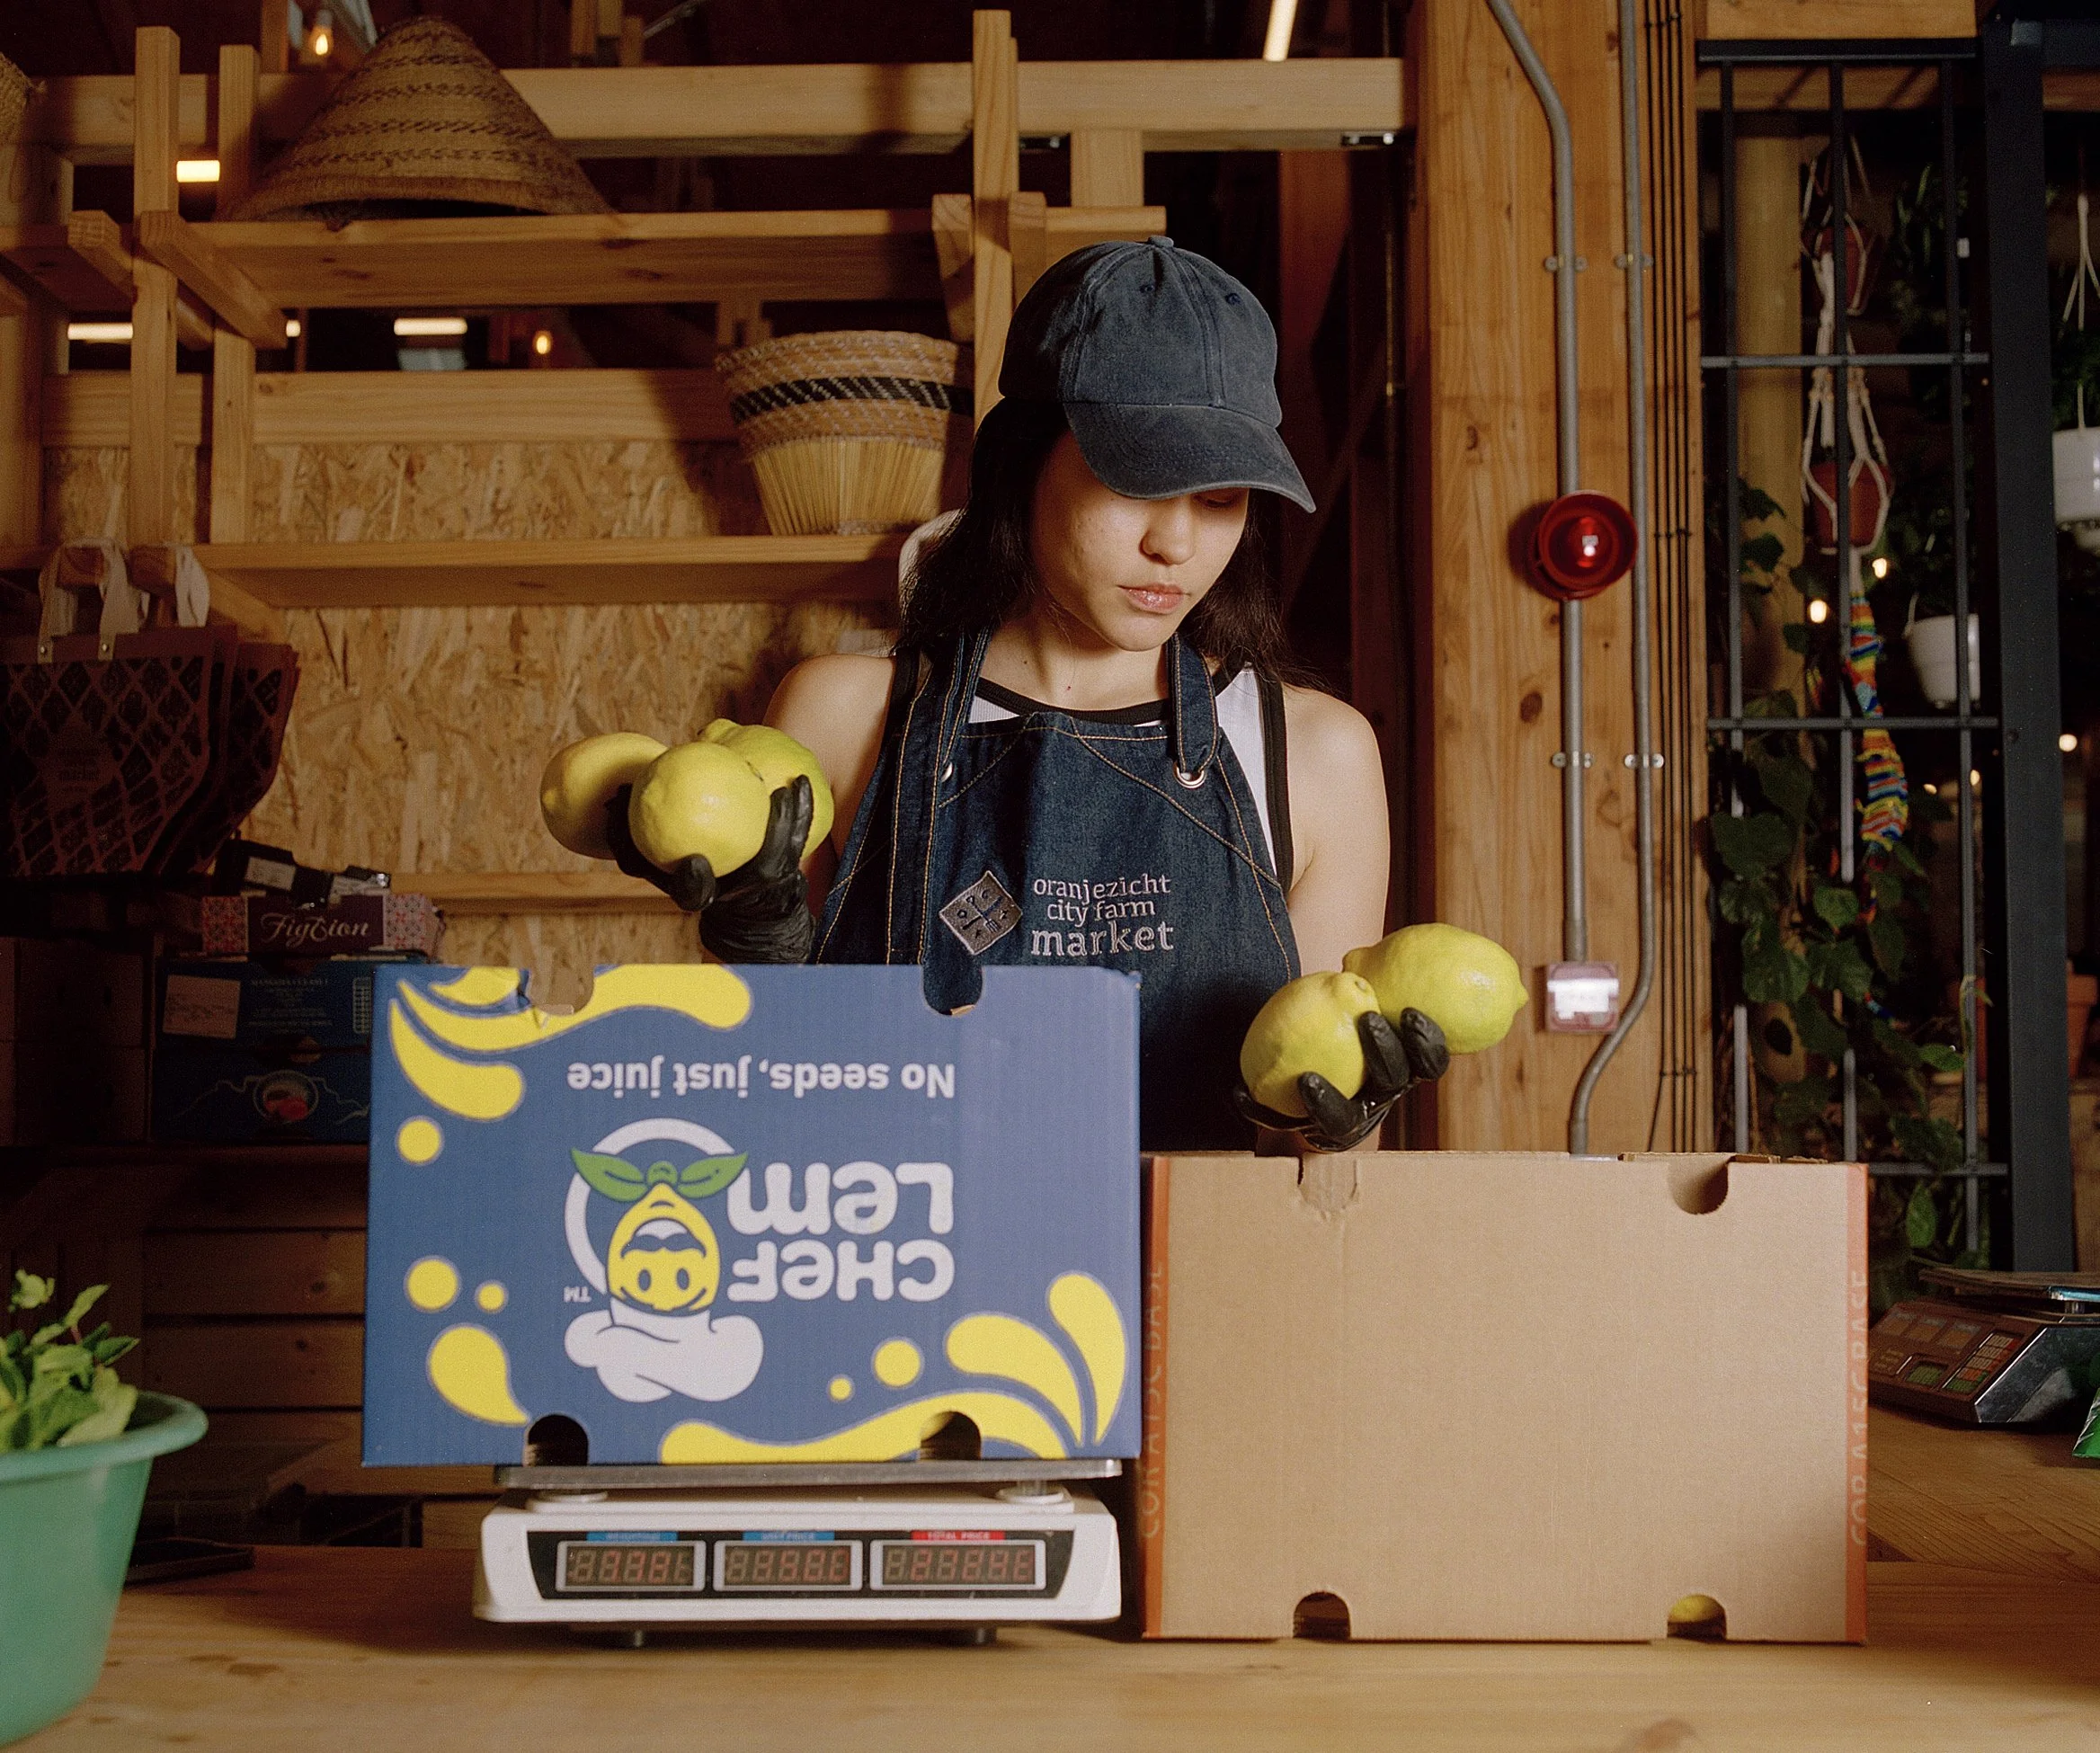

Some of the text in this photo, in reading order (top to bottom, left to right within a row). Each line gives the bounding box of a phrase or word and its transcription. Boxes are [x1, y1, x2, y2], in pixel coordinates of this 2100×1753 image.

[1034, 873, 1171, 904] oranjezicht
[1047, 899, 1155, 928] city farm
[1030, 920, 1174, 958] market
[566, 1055, 956, 1099] No seeds, just juice
